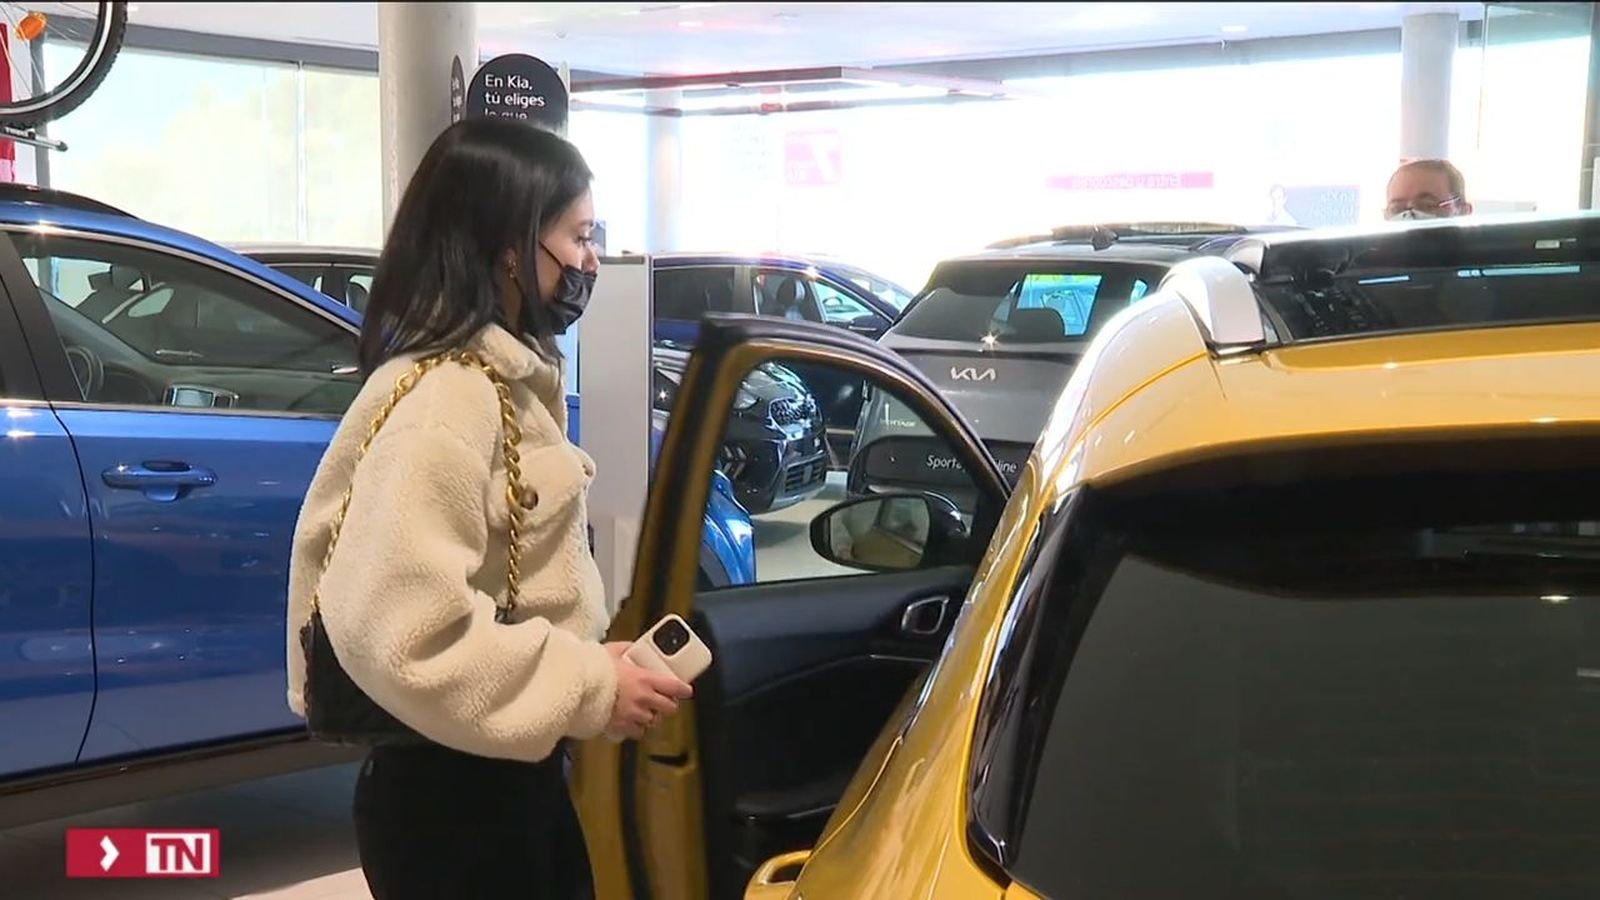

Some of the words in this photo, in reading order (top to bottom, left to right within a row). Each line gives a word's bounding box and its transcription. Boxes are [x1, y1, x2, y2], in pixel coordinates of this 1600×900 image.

[484, 74, 503, 87] En
[507, 74, 533, 90] Kia,
[484, 92, 500, 104] tú
[504, 93, 545, 108] eliges
